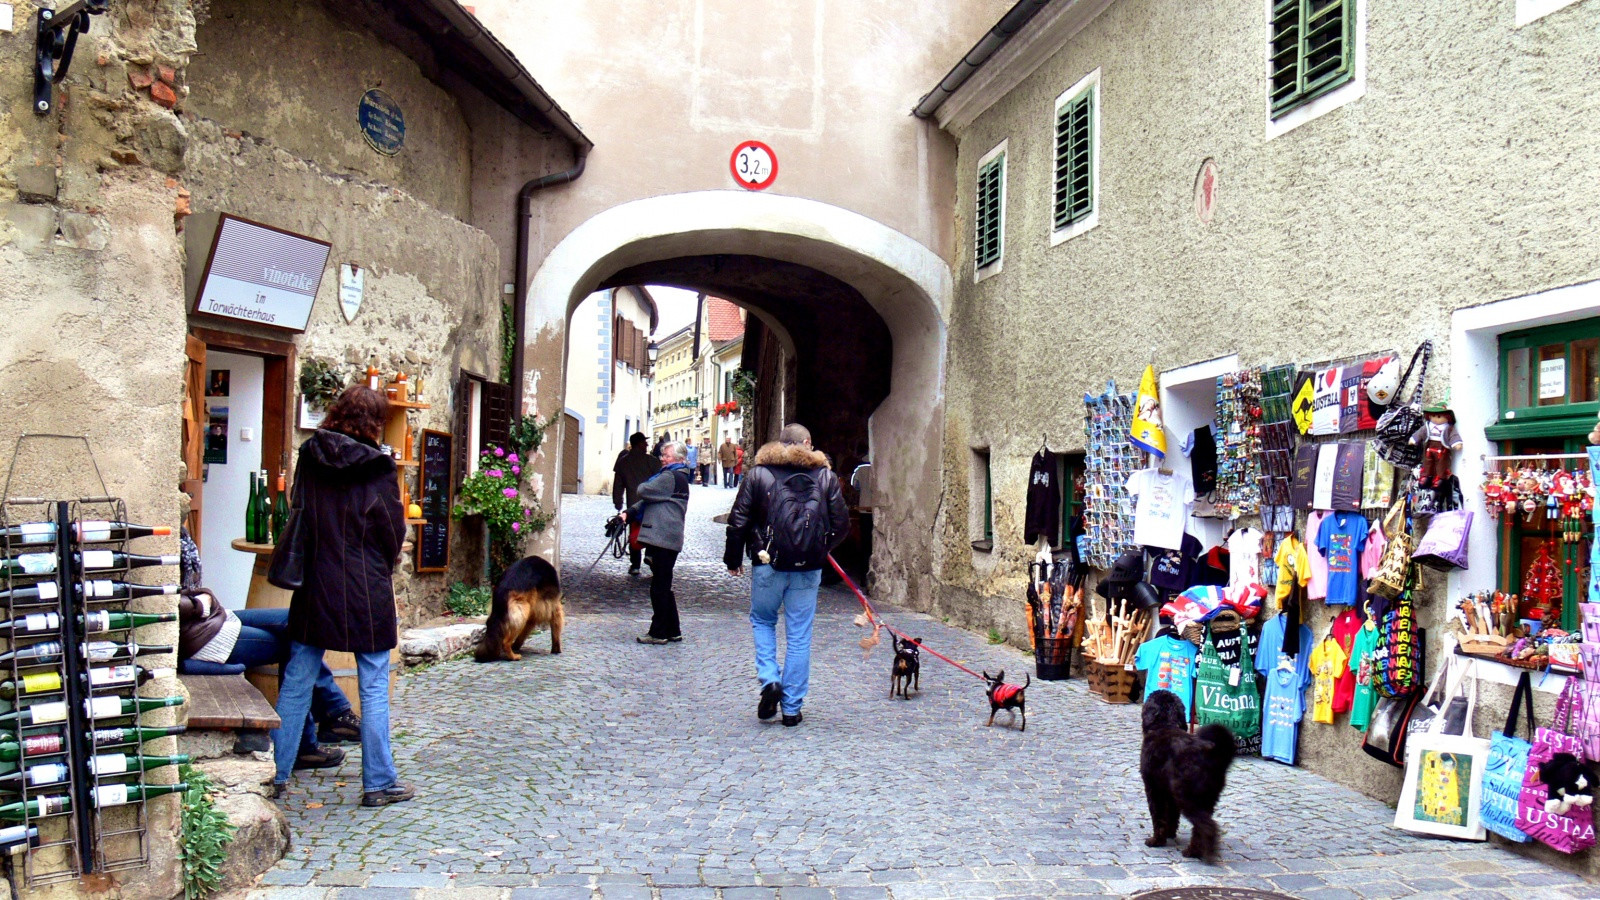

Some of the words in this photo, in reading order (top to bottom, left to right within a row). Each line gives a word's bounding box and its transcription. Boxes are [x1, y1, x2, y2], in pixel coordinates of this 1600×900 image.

[264, 265, 314, 290] vinotake
[255, 290, 267, 304] im
[208, 298, 276, 323] Torwächterhaus
